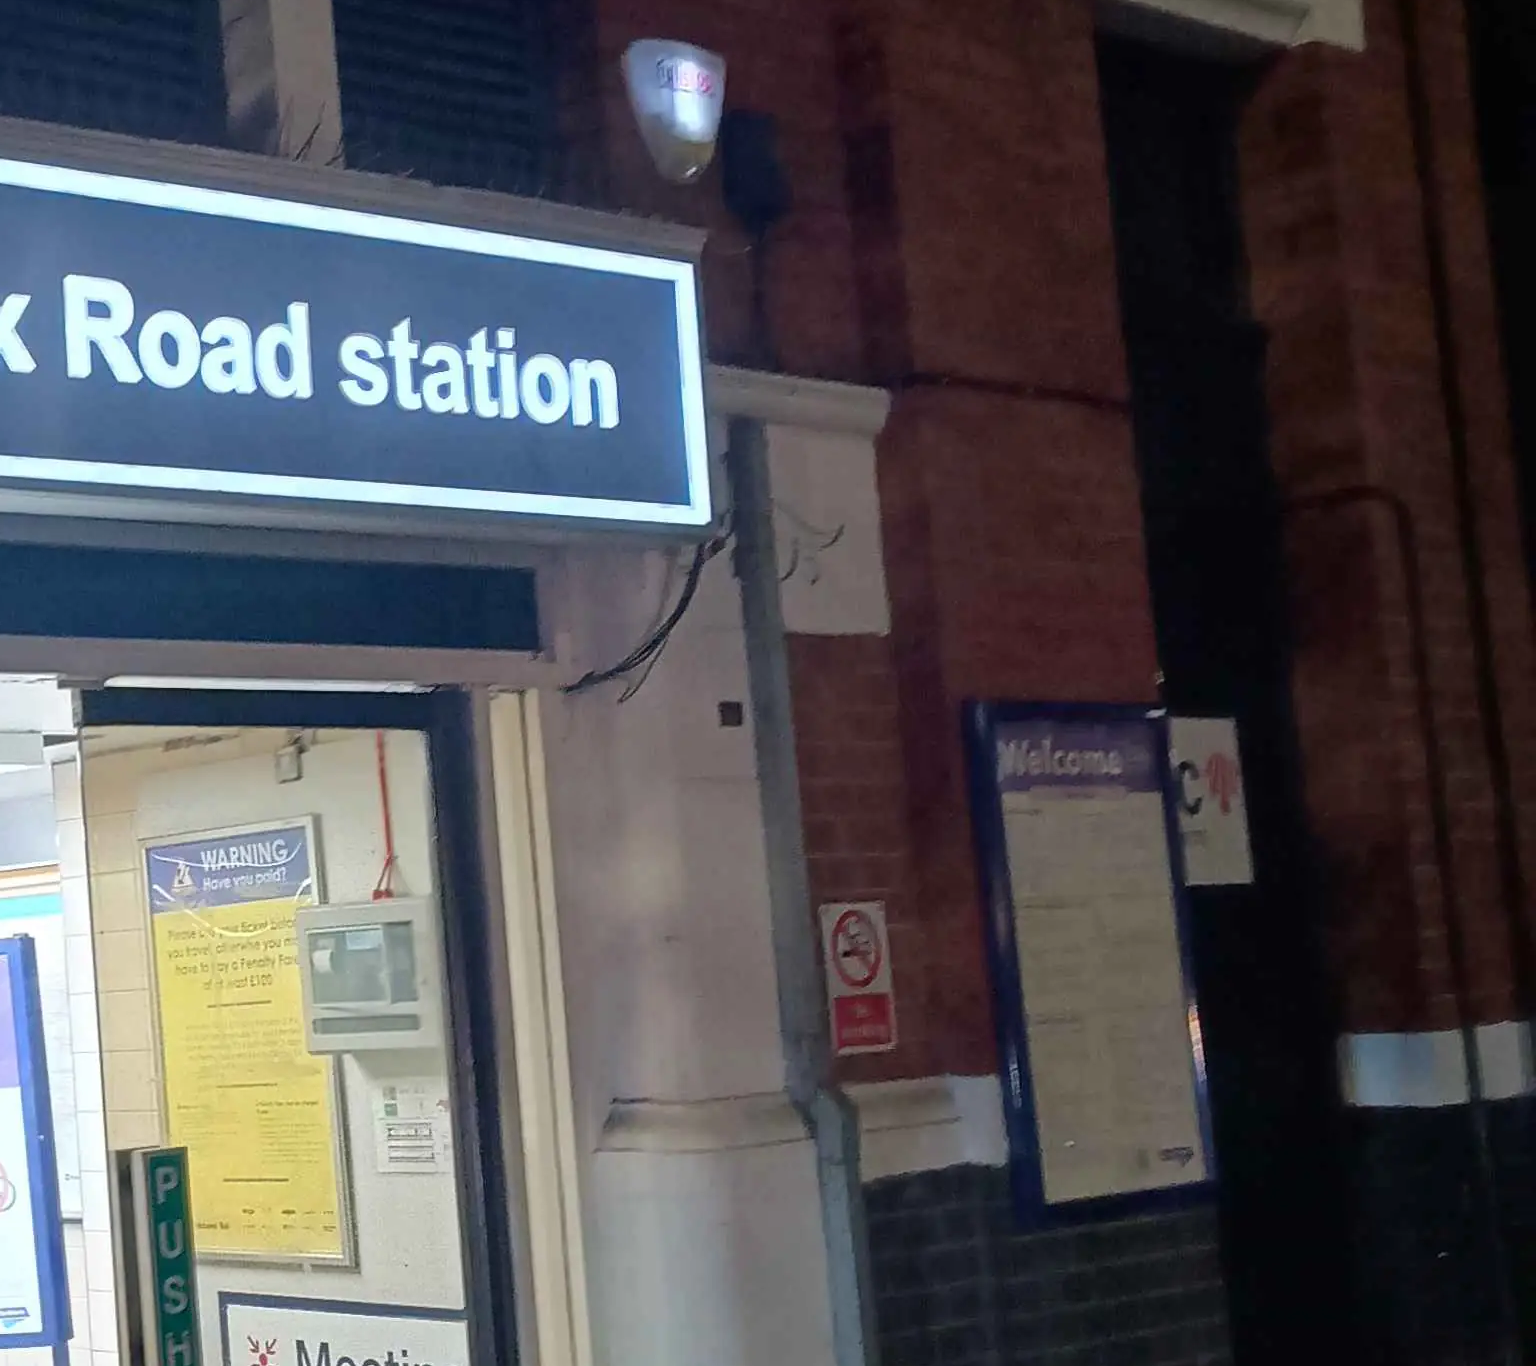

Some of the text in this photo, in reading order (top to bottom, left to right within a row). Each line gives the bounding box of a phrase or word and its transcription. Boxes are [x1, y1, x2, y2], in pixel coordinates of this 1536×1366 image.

[63, 273, 314, 400] Road
[338, 317, 620, 430] station
[996, 737, 1124, 777] Welcome
[200, 839, 289, 872] WARNING
[203, 866, 288, 892] Have you paid?
